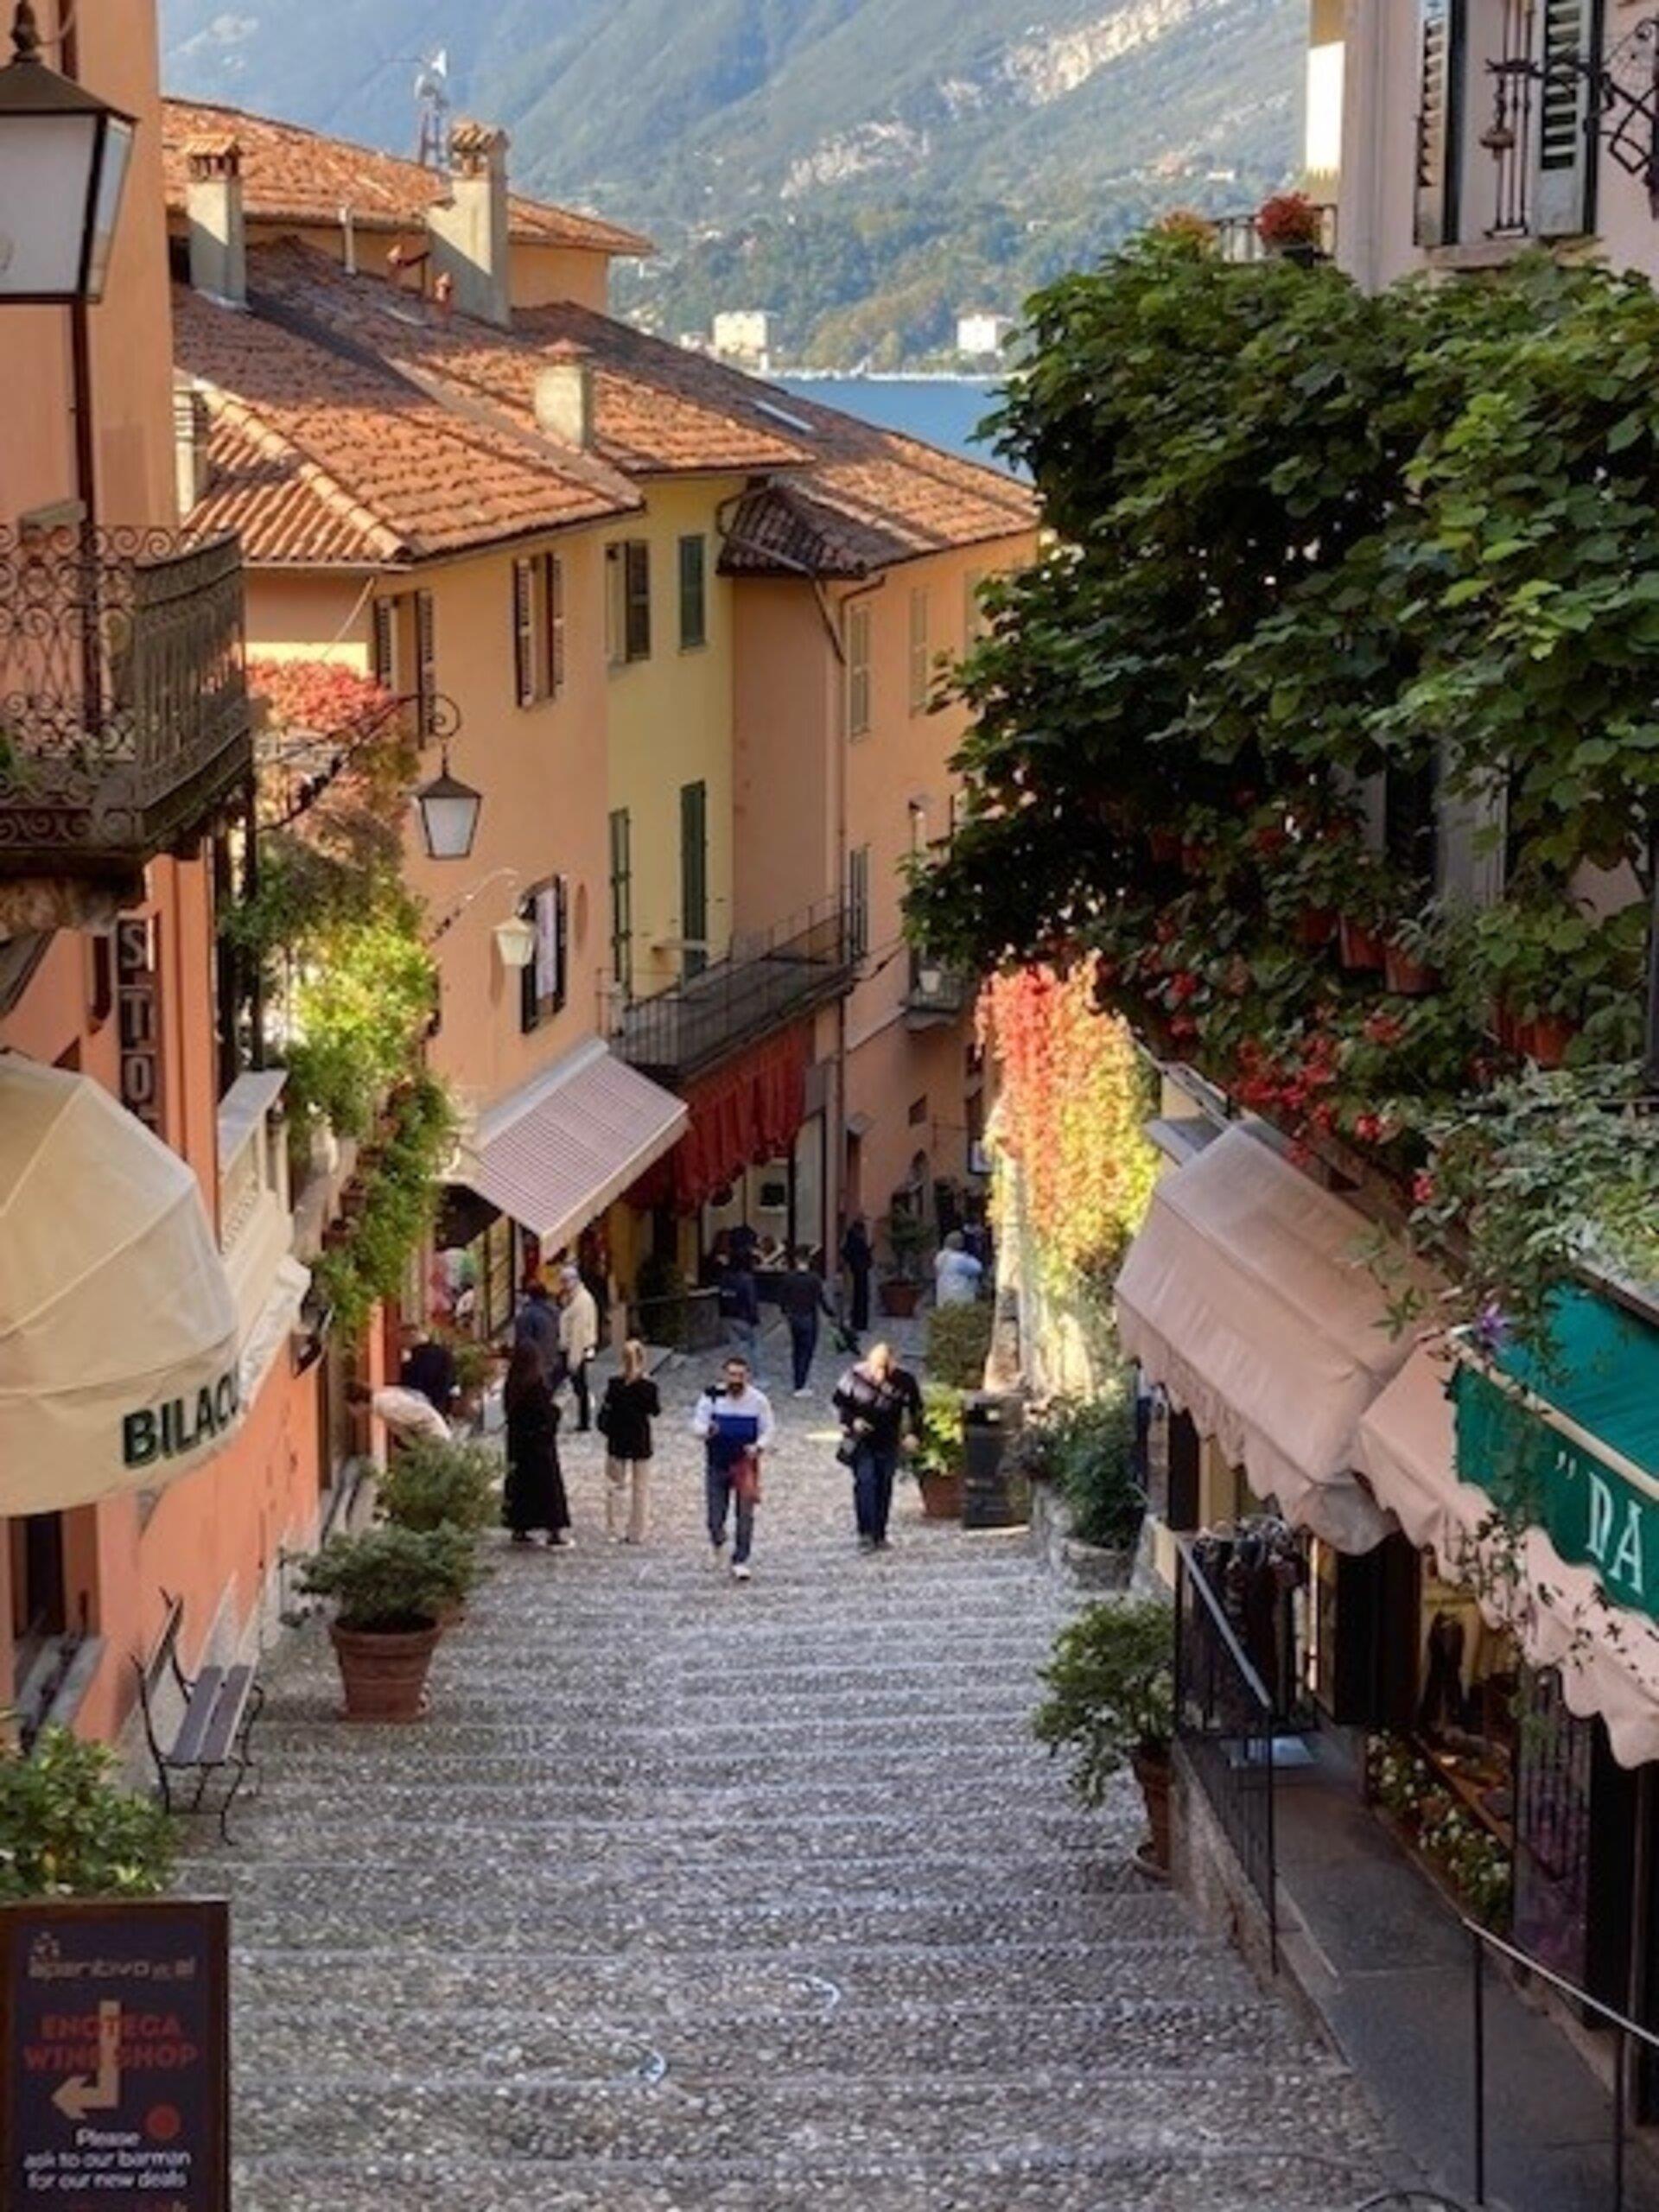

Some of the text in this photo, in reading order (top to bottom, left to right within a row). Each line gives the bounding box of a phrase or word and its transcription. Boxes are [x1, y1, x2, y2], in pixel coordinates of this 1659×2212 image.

[41, 2013, 181, 2038] ENOTECA
[114, 2043, 199, 2069] SHOP
[75, 2128, 142, 2146] Please
[23, 2151, 192, 2169] ask to our barman
[27, 2169, 188, 2189] for our new deals
